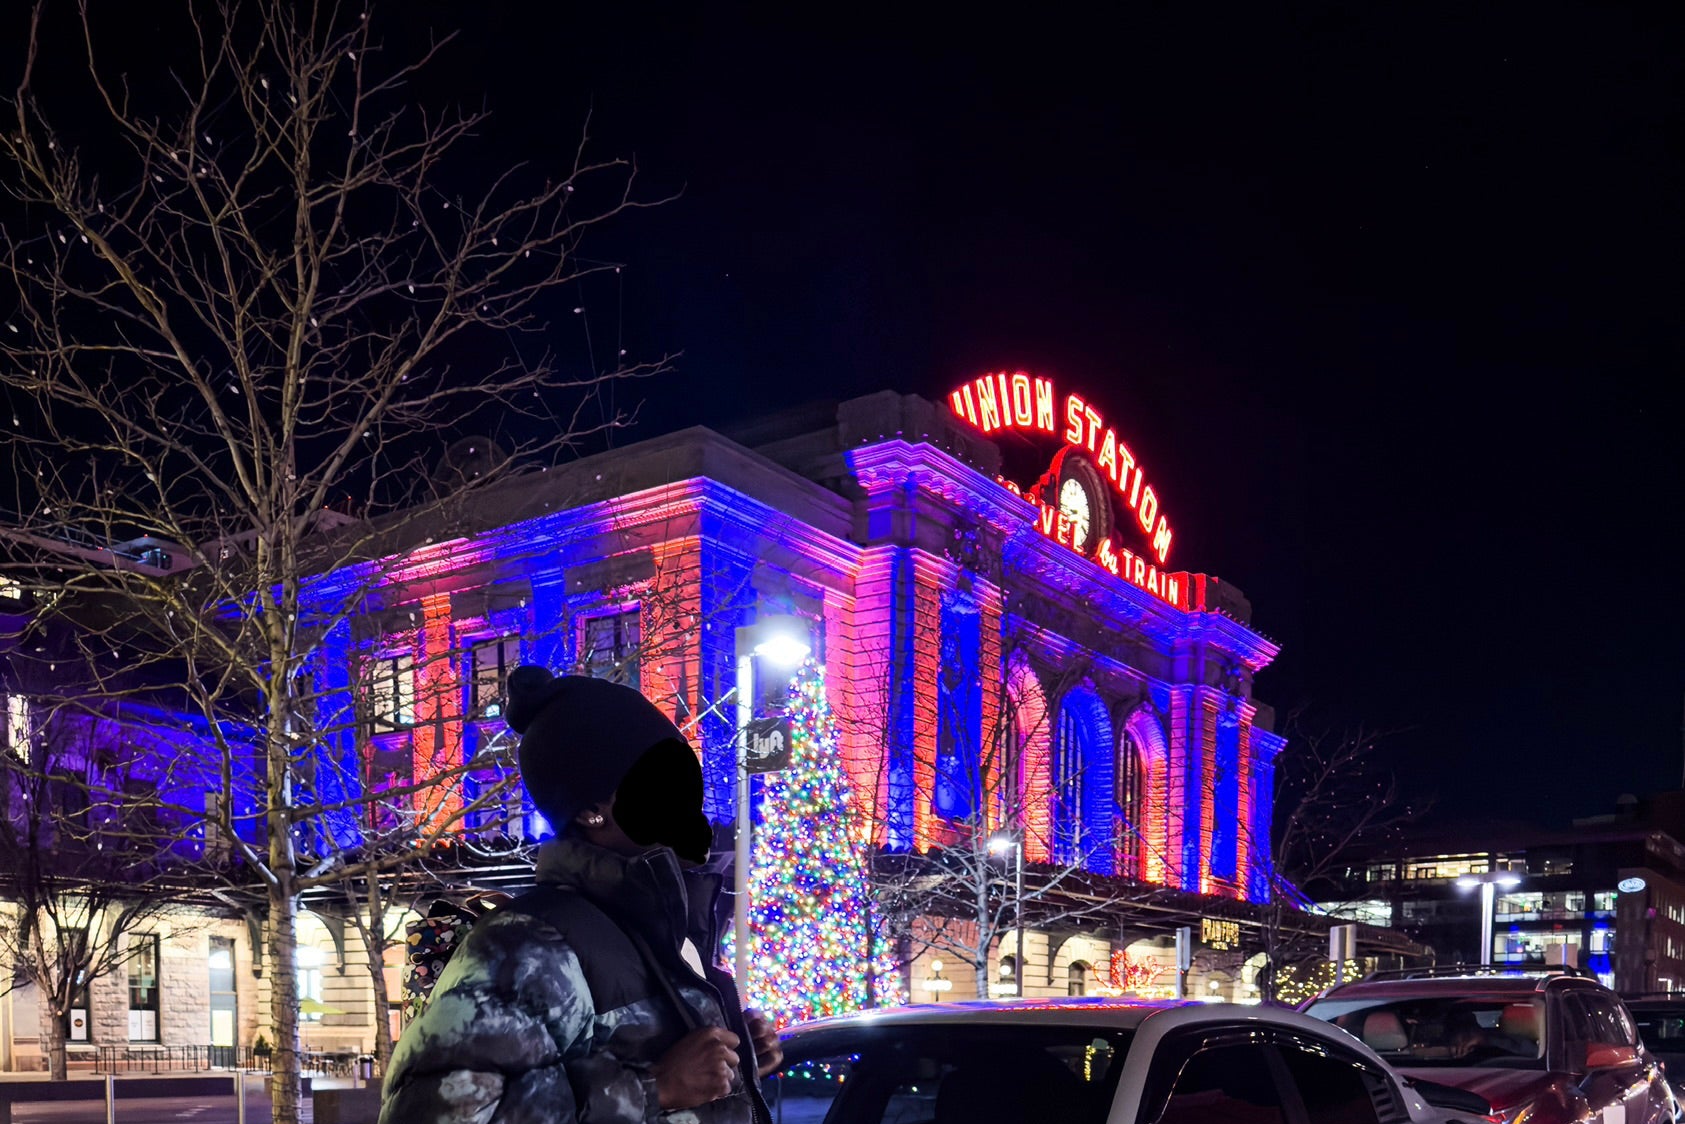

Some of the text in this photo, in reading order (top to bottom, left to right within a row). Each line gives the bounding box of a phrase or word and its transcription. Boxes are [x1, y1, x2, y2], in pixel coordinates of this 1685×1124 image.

[952, 373, 1173, 563] UNION STATION
[1122, 548, 1179, 605] TRAIN
[753, 730, 784, 759] lyft
